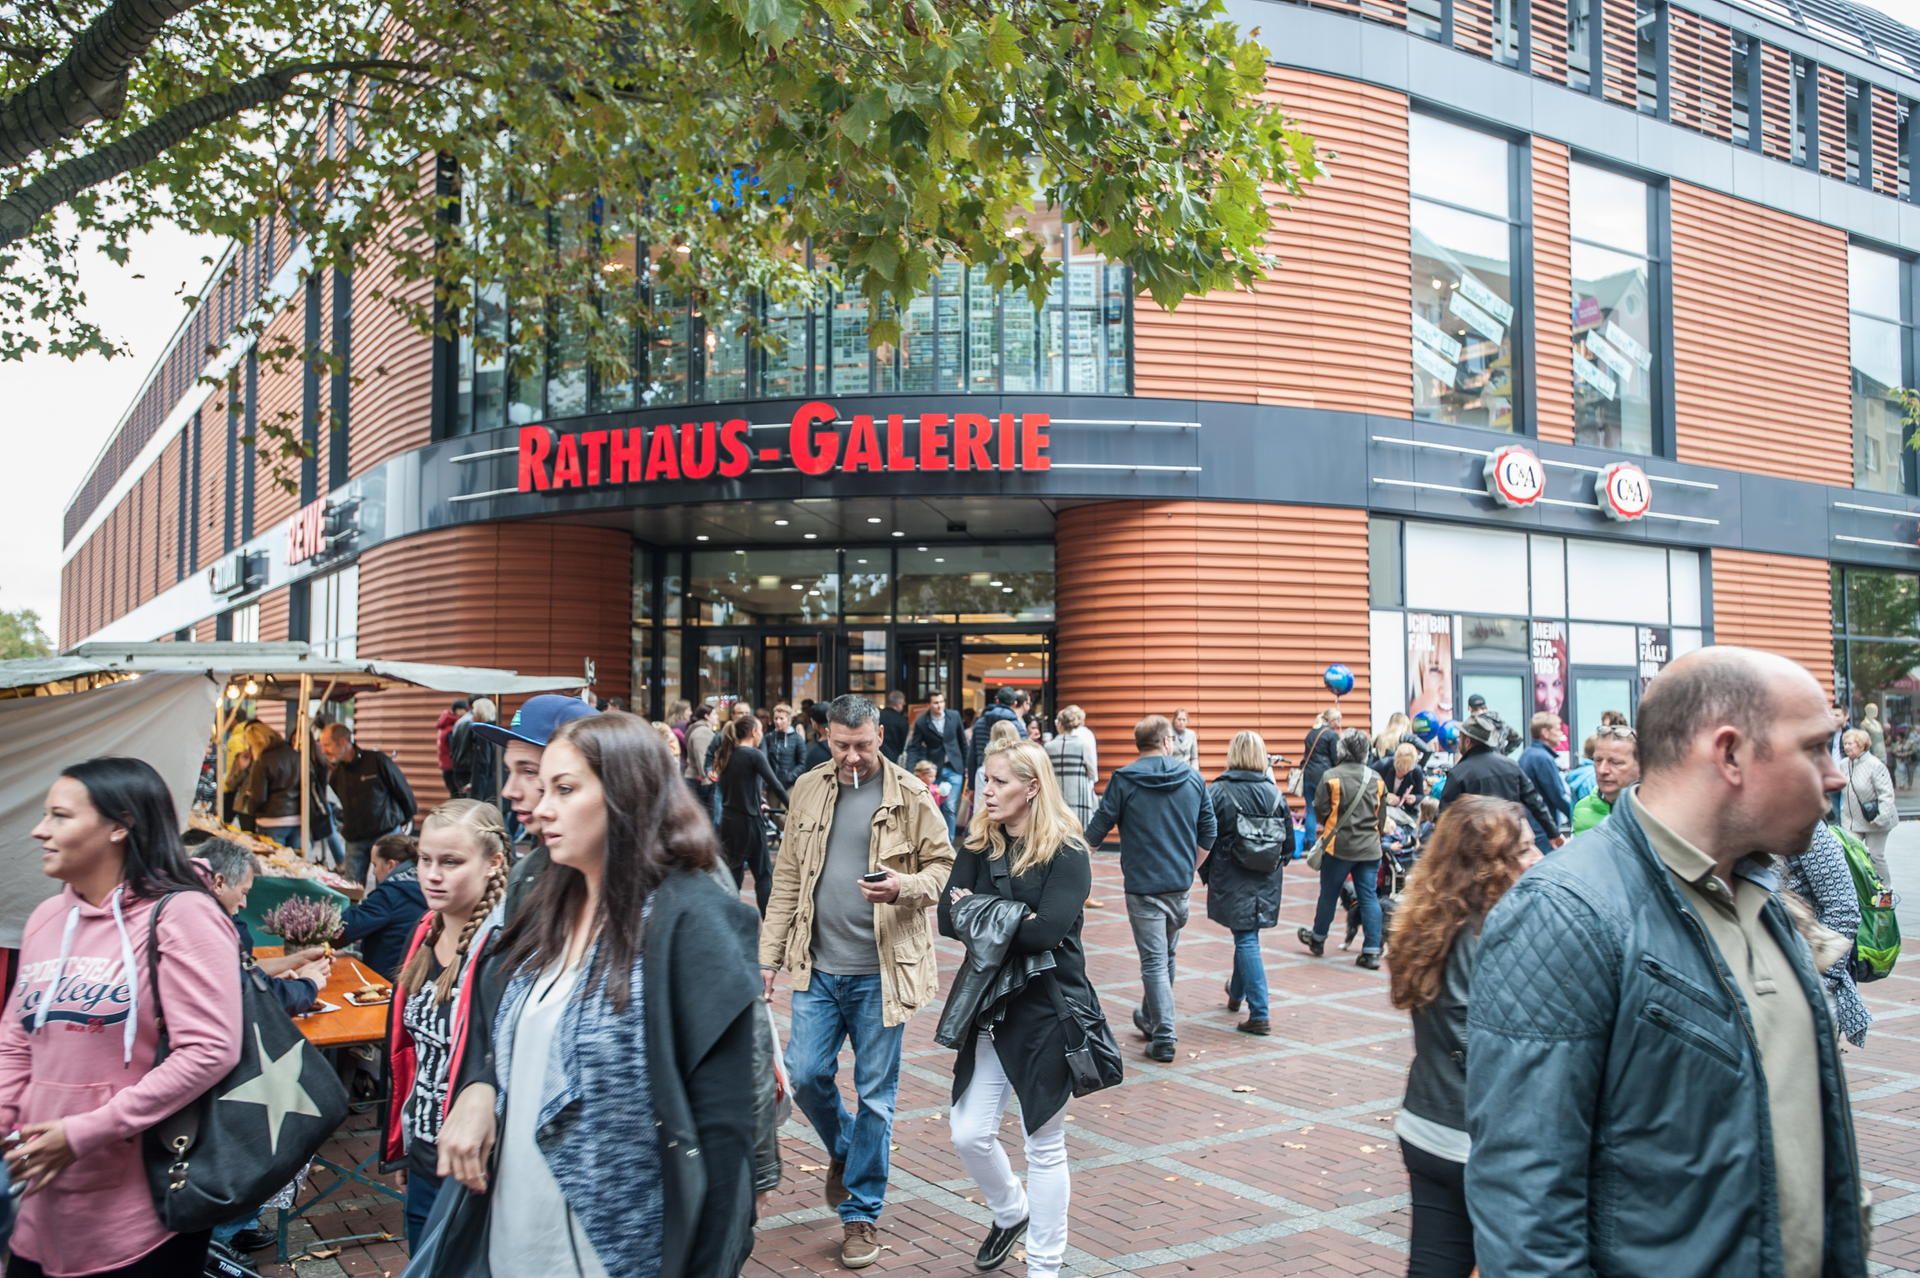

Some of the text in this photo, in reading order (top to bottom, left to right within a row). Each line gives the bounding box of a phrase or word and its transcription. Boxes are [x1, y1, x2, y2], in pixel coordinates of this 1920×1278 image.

[517, 401, 1050, 493] RATHAUS-GALERIE
[1506, 462, 1537, 489] C&A
[1617, 478, 1644, 503] C&A
[289, 497, 327, 567] REWE
[1408, 613, 1428, 632] ICH
[1430, 616, 1450, 634] BIN
[1532, 622, 1559, 640] MEIN
[1533, 640, 1557, 657] STA-
[218, 1260, 242, 1278] TURBO
